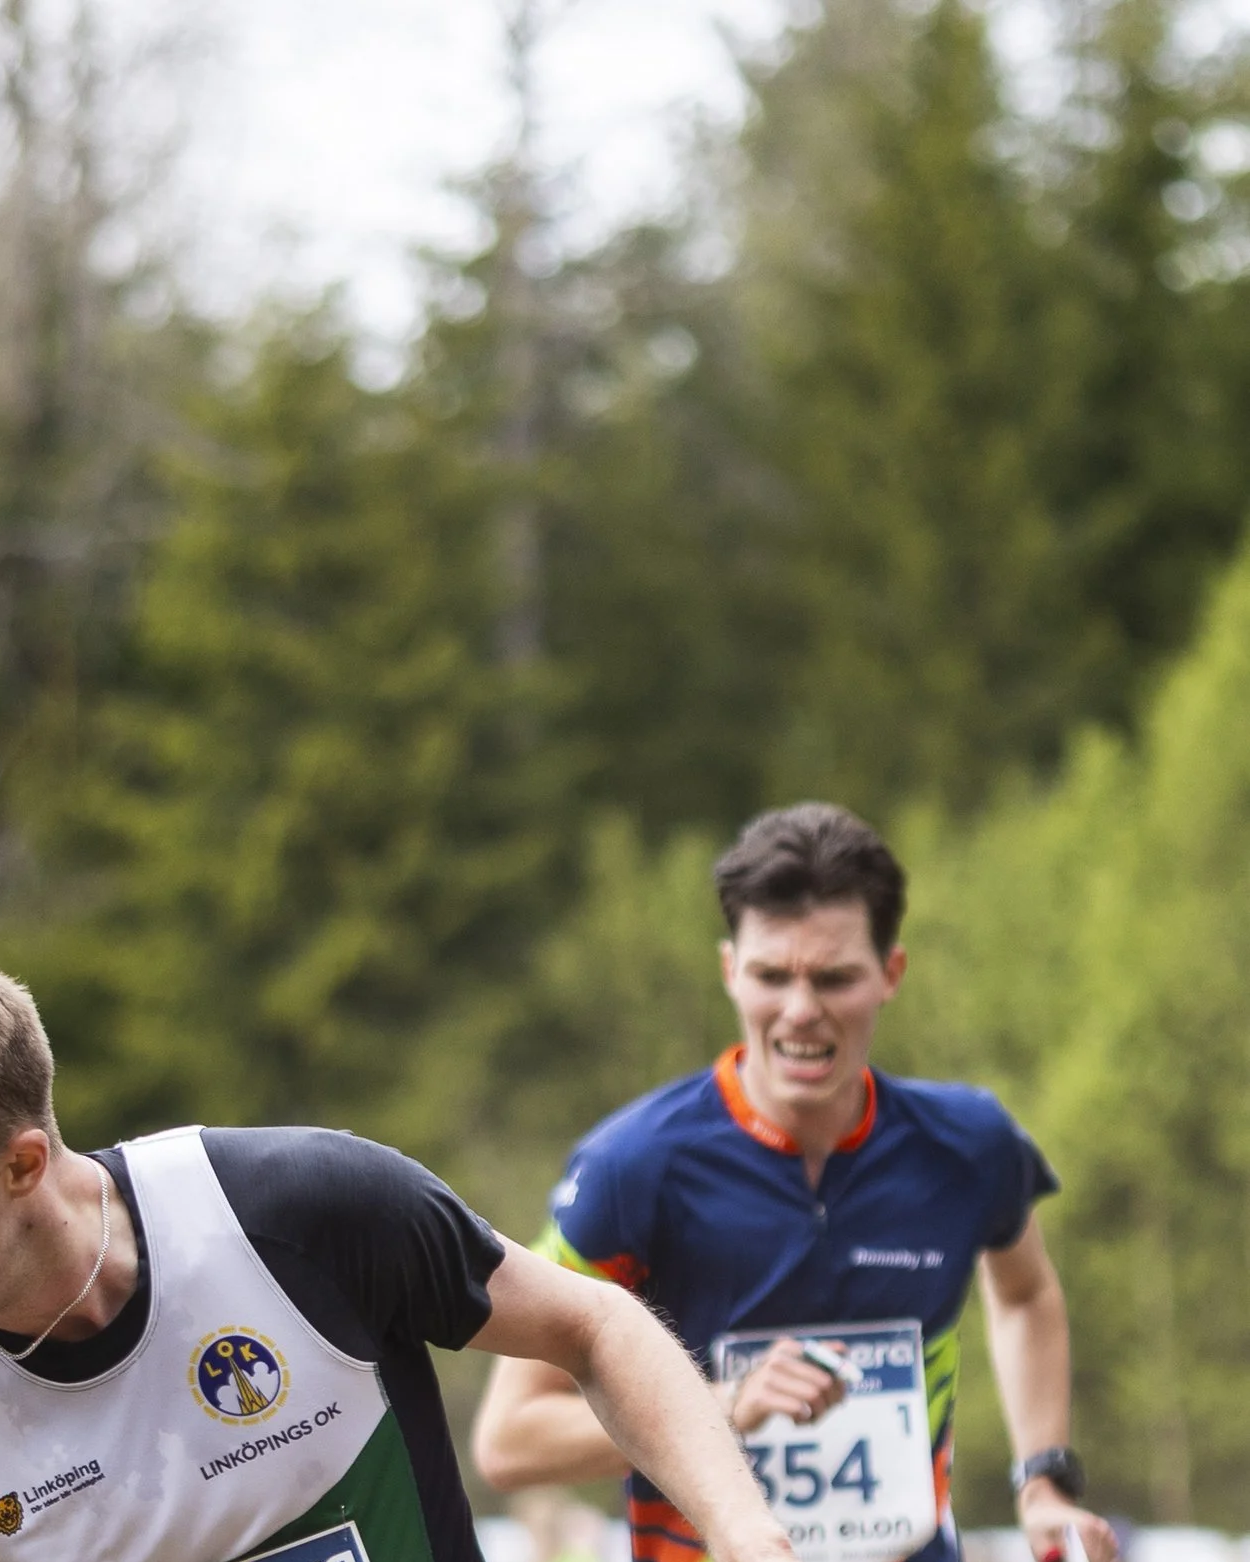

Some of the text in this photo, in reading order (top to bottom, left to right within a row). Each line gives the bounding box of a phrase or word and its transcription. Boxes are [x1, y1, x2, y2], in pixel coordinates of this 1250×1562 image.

[200, 1402, 342, 1480] LINKÖPINGS OK
[897, 1404, 912, 1437] 1
[23, 1459, 101, 1504] Linköping
